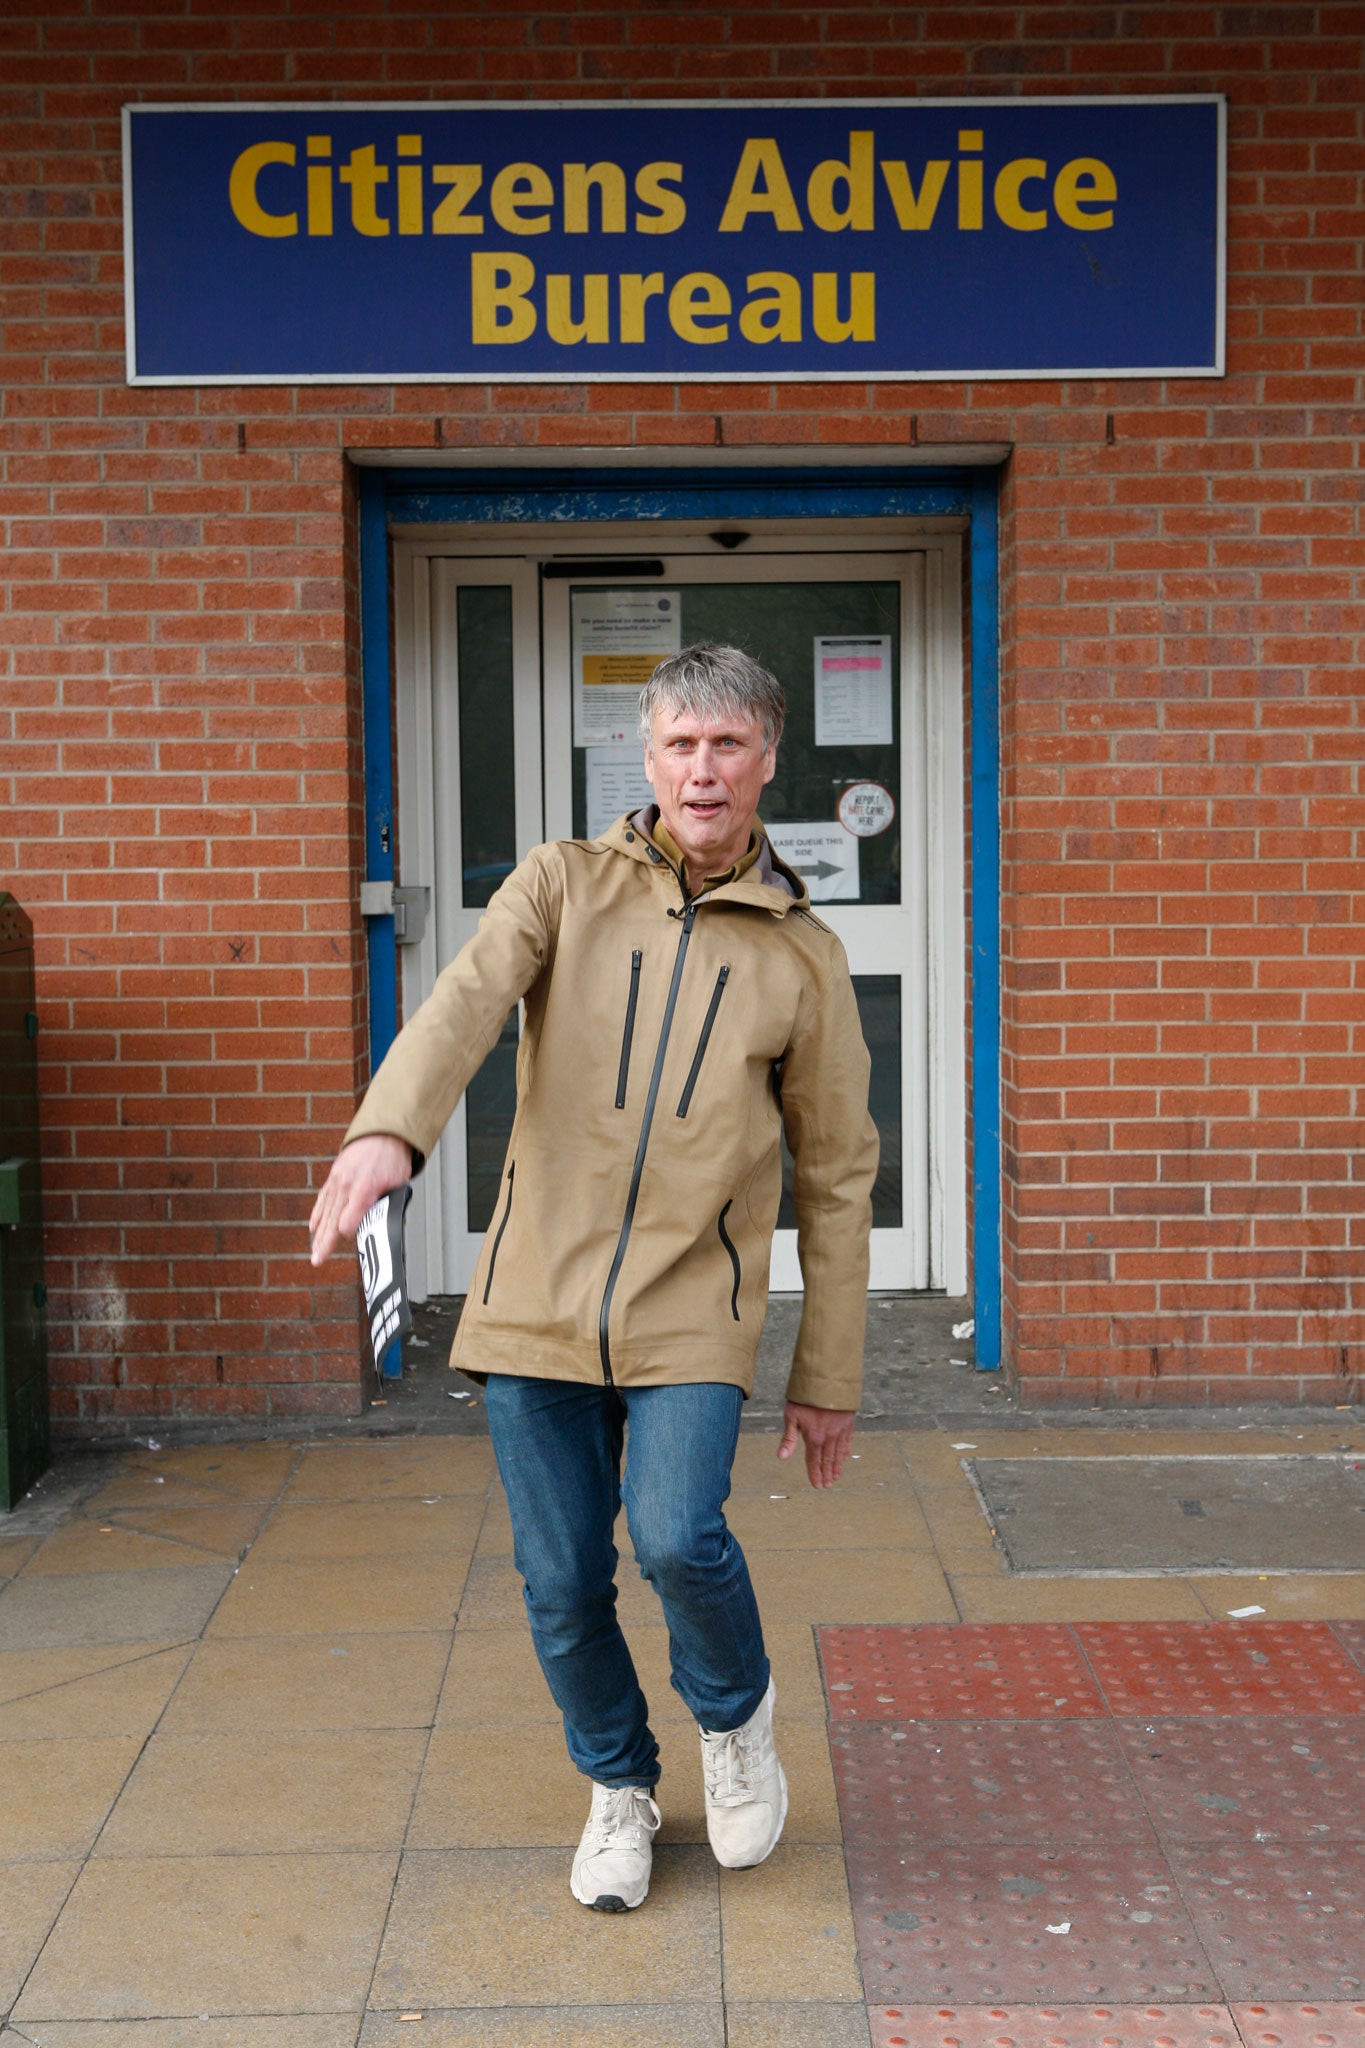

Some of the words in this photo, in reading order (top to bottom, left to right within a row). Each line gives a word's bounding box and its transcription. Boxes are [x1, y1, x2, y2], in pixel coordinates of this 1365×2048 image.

[228, 134, 687, 238] Citizens
[718, 129, 1118, 232] Advice
[471, 251, 876, 346] Bureau
[855, 795, 879, 806] REPORT
[774, 839, 794, 847] EASE
[796, 838, 824, 847] QUEUE
[825, 837, 844, 845] THIS
[794, 849, 813, 857] SIDE
